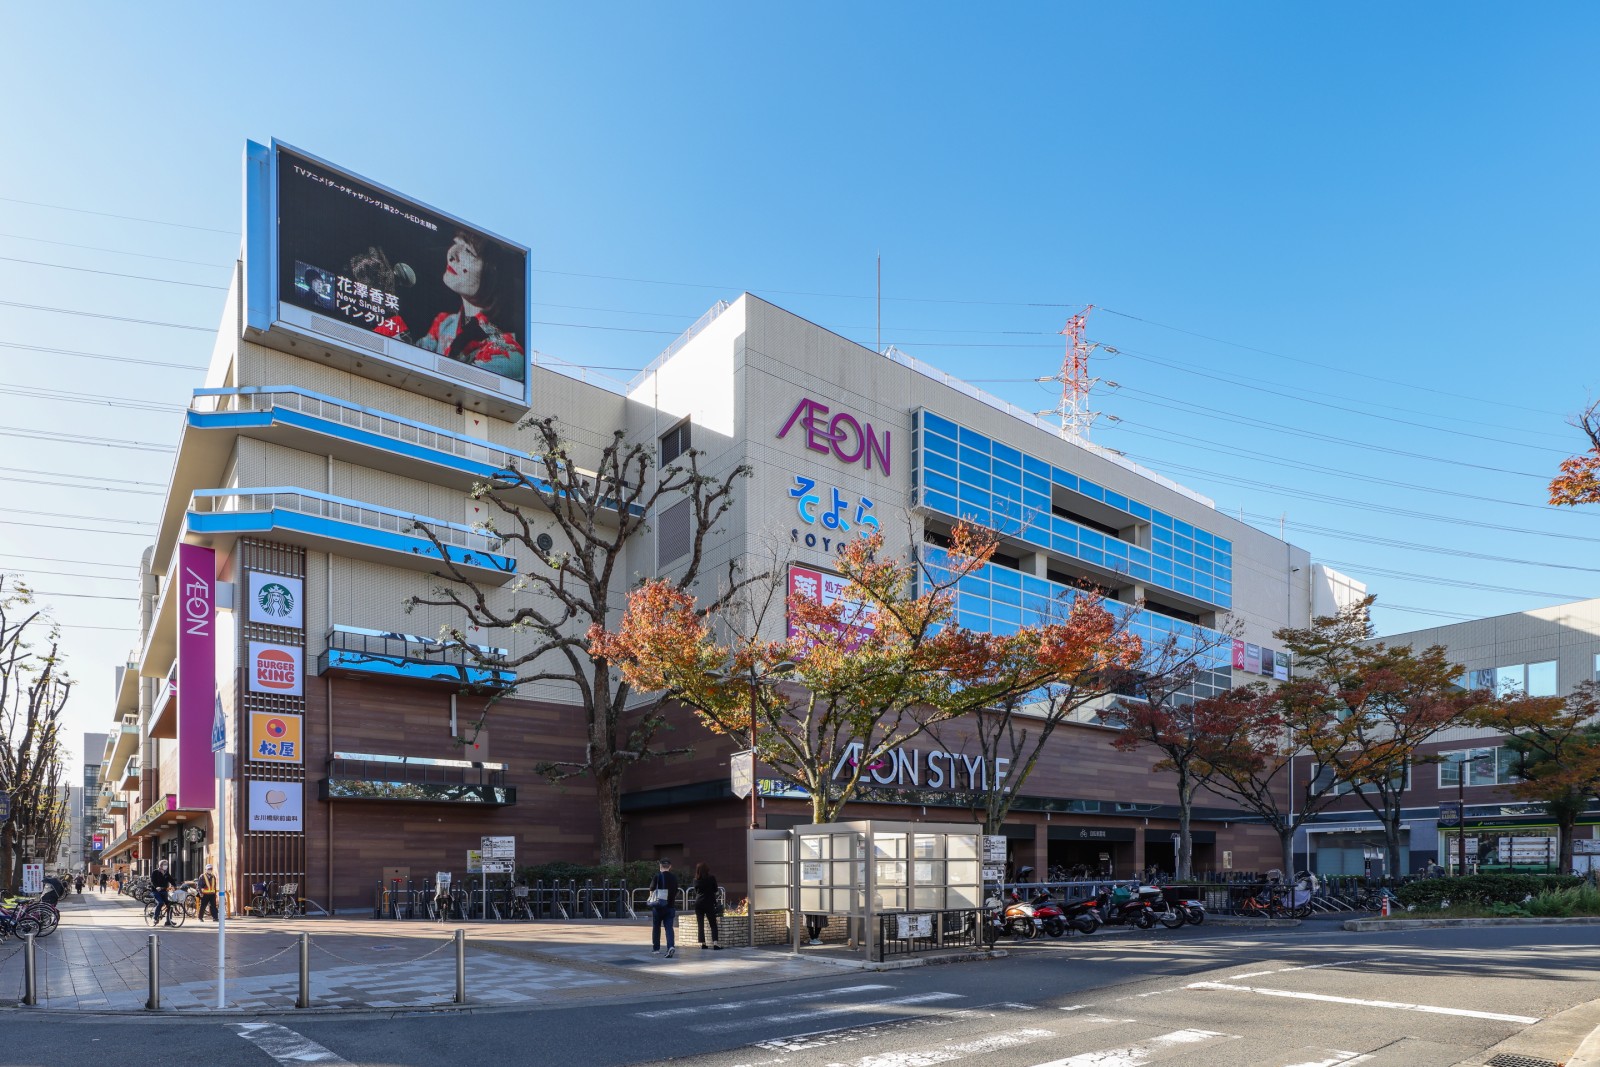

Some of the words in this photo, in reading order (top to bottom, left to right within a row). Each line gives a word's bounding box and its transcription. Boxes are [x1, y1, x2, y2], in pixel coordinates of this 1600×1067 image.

[336, 291, 356, 304] New
[359, 299, 386, 315] Single
[337, 275, 400, 311] 花澤香菜
[336, 299, 400, 333] 「インタリオ」
[787, 475, 880, 539] そよら
[257, 660, 295, 672] BURGER
[257, 668, 295, 683] KING
[258, 739, 295, 758] 松屋
[927, 749, 1011, 793] STYLE
